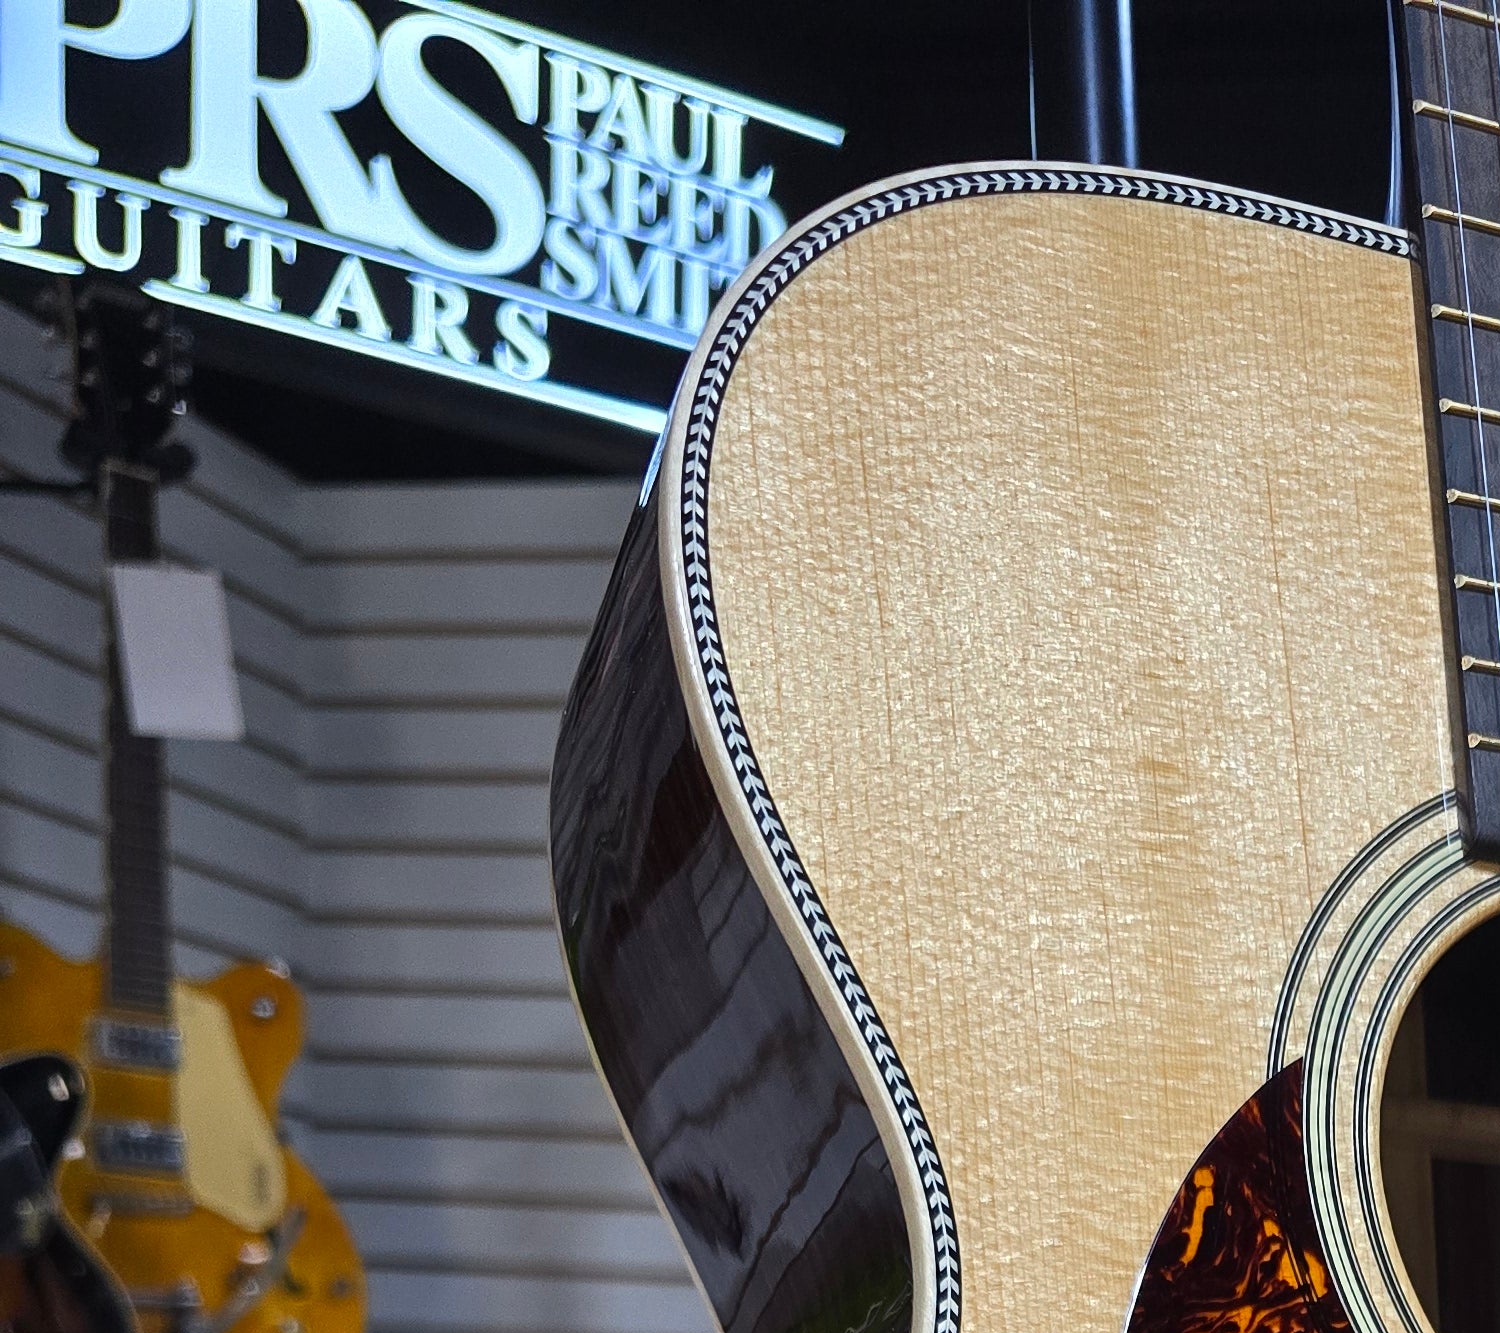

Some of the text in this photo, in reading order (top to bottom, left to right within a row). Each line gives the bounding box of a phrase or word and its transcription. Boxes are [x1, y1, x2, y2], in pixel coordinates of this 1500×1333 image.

[0, 0, 546, 276] PRS
[543, 49, 775, 198] PAUL
[543, 133, 788, 271] REED
